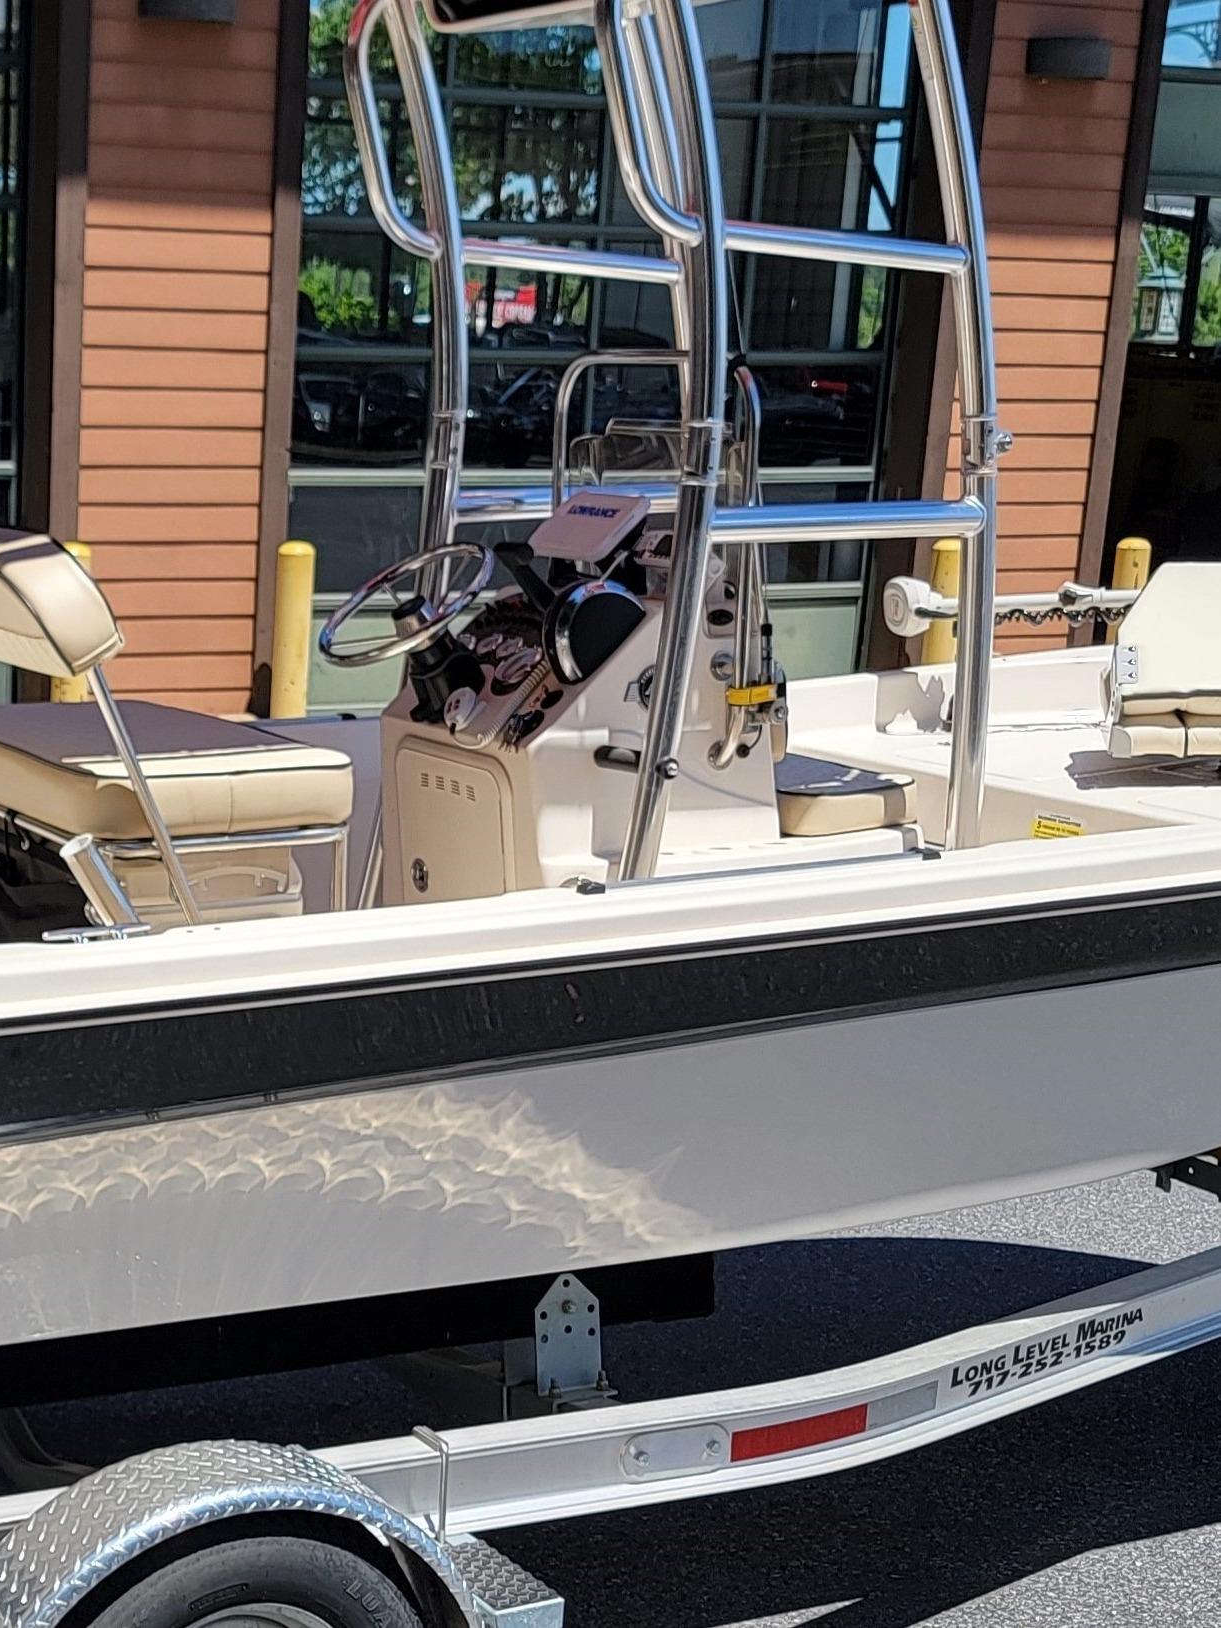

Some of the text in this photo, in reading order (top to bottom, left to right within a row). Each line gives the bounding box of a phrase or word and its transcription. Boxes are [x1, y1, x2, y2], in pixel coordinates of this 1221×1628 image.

[950, 1307, 1144, 1389] LONG LEVEL MARINA
[967, 1329, 1127, 1398] 717-252-1589
